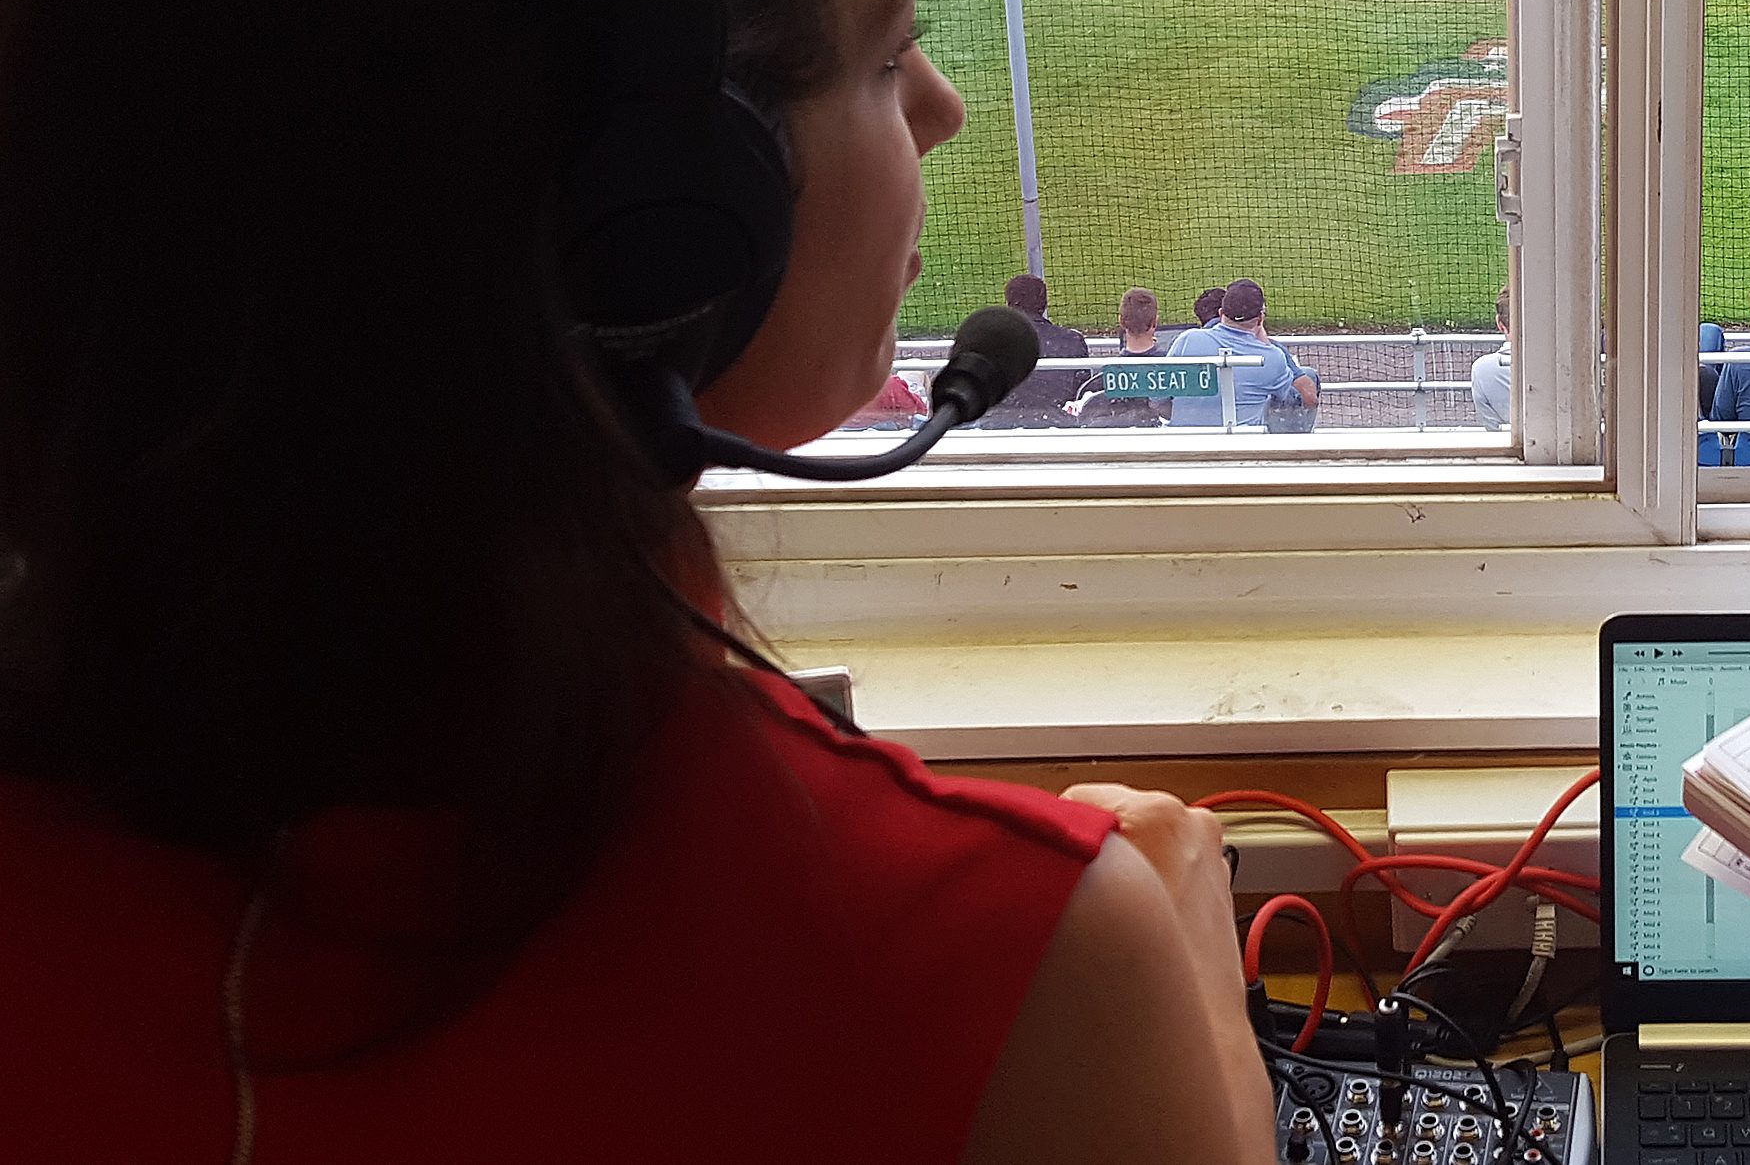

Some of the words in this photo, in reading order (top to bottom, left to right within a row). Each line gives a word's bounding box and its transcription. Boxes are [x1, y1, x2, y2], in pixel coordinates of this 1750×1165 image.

[1106, 371, 1140, 392] BOX
[1148, 370, 1187, 391] SEAT
[1199, 370, 1209, 390] G
